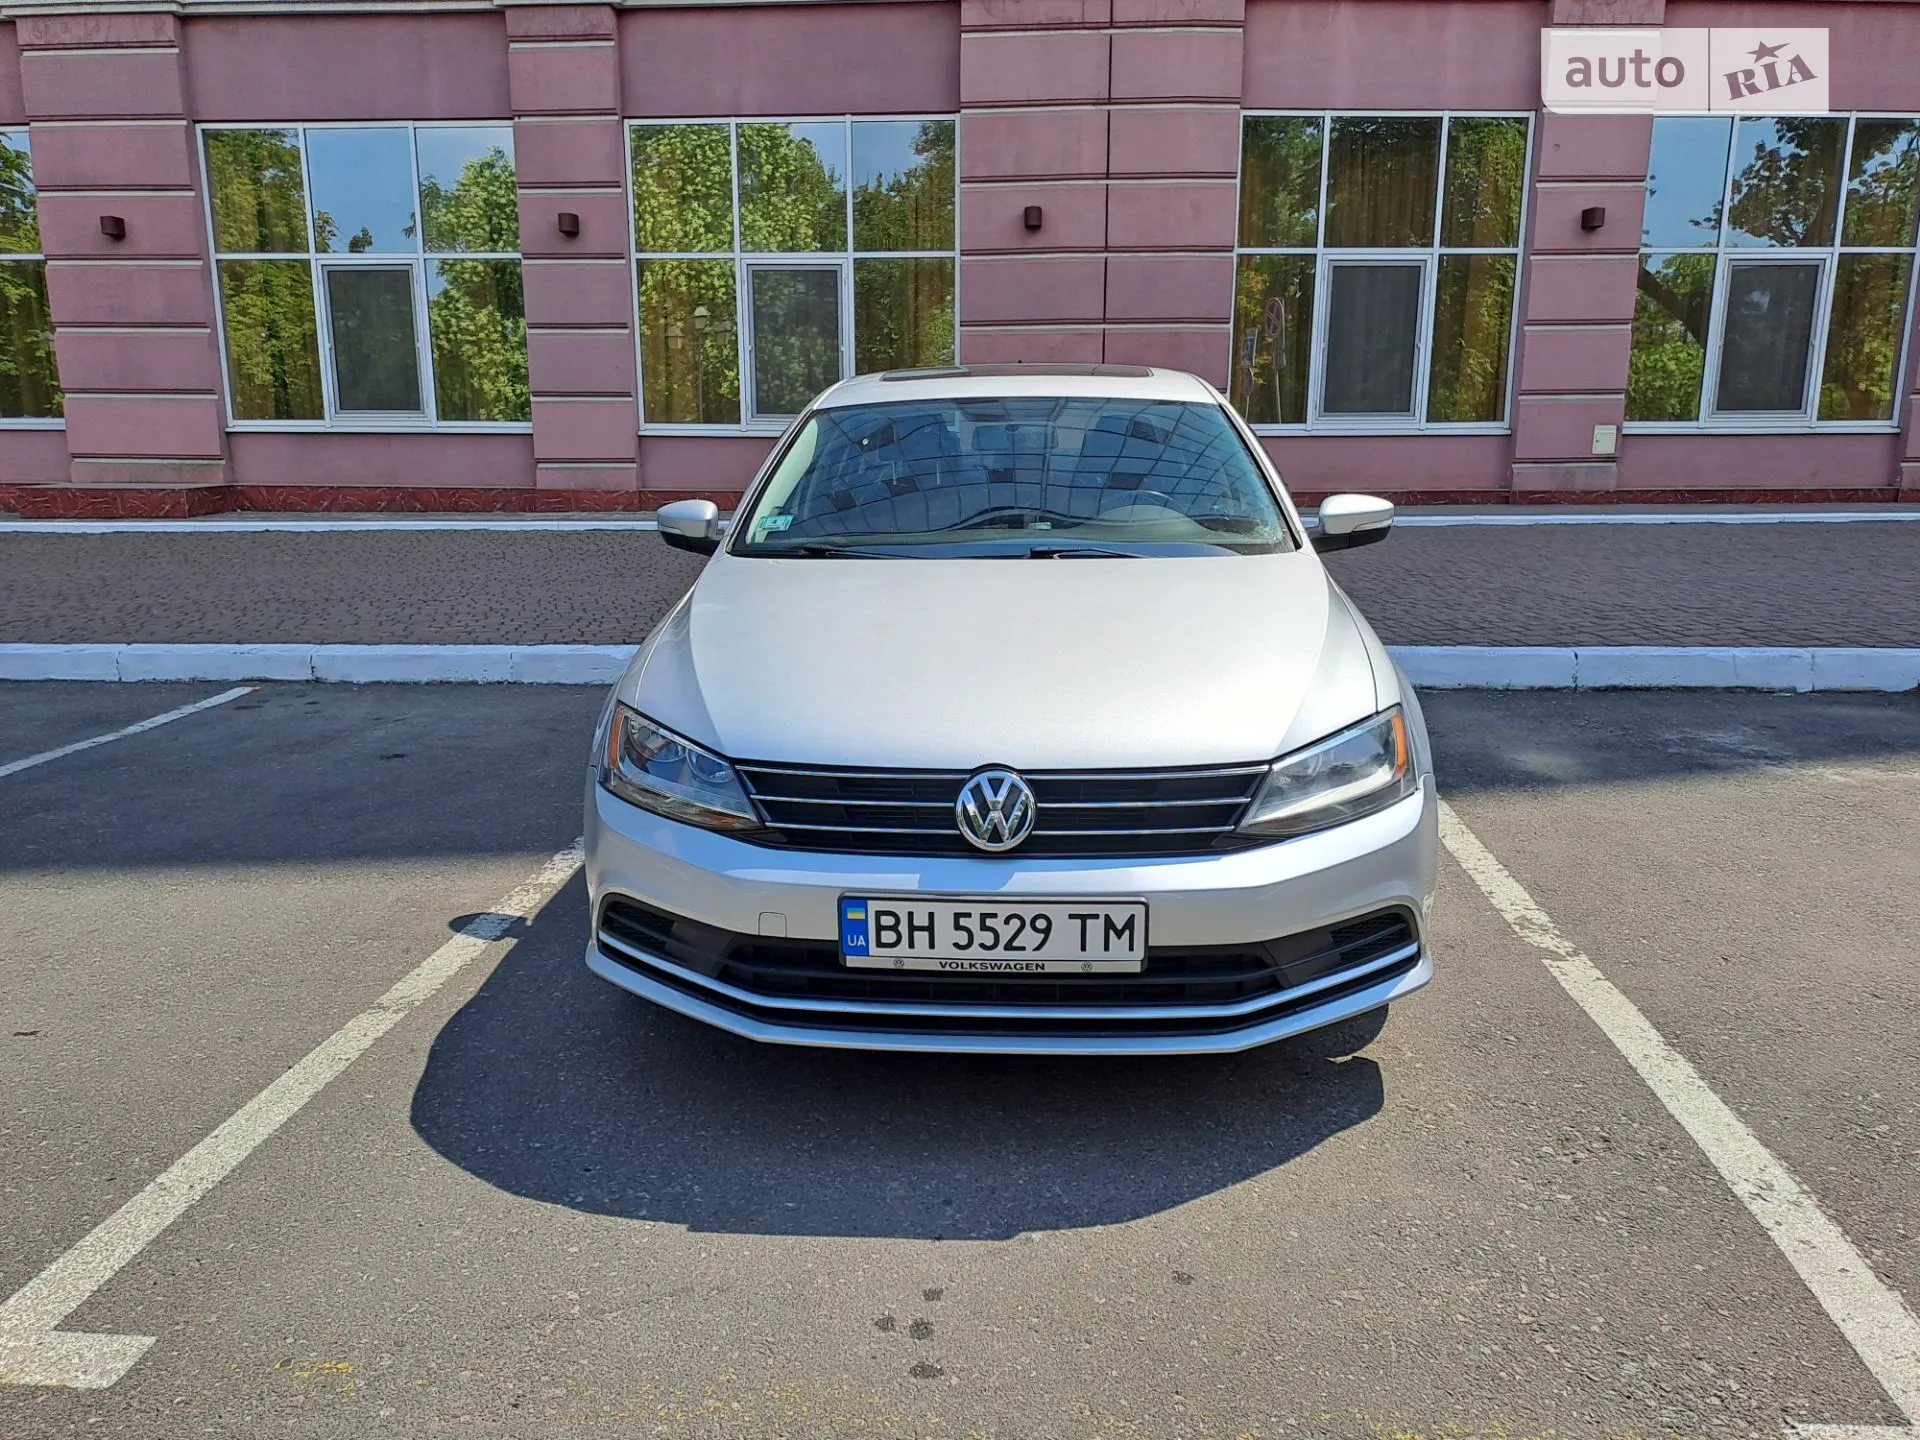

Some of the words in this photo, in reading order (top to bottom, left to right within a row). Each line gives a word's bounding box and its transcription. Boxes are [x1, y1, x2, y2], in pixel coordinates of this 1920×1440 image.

[874, 910, 936, 950] BH
[952, 912, 1053, 951] 5529
[1068, 913, 1136, 952] TM
[847, 934, 867, 947] UA
[938, 960, 1046, 972] VOLKSWAGEN
